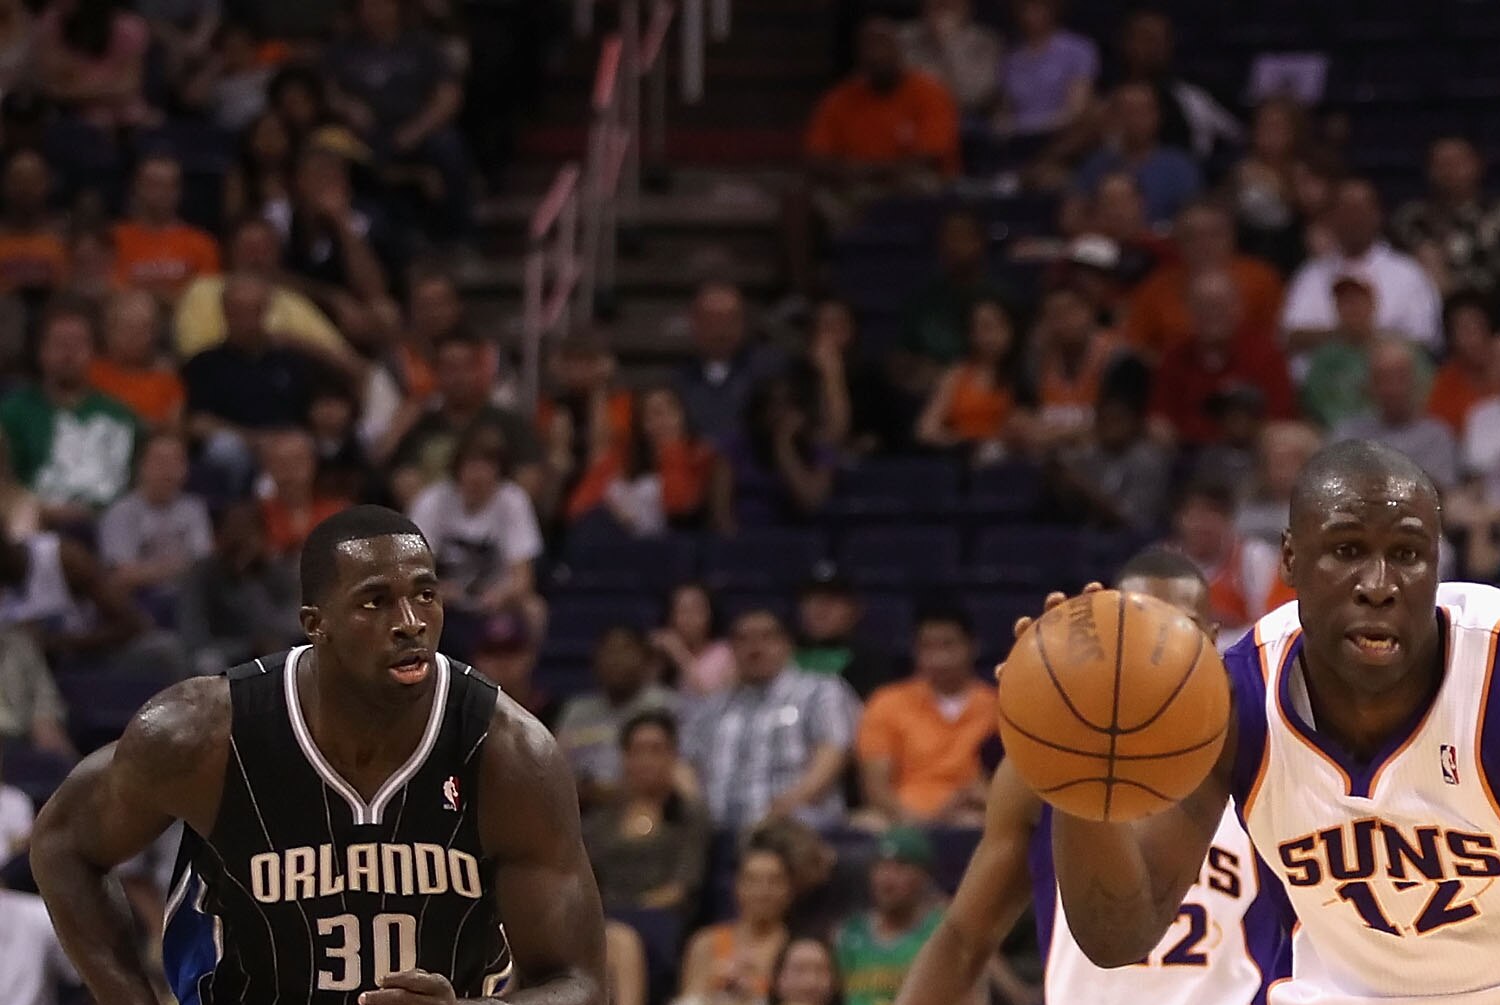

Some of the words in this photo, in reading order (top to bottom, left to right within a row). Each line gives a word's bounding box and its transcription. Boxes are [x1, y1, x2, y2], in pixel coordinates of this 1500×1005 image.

[250, 842, 483, 903] ORLANDO
[1335, 880, 1481, 938] 12
[317, 912, 417, 991] 30
